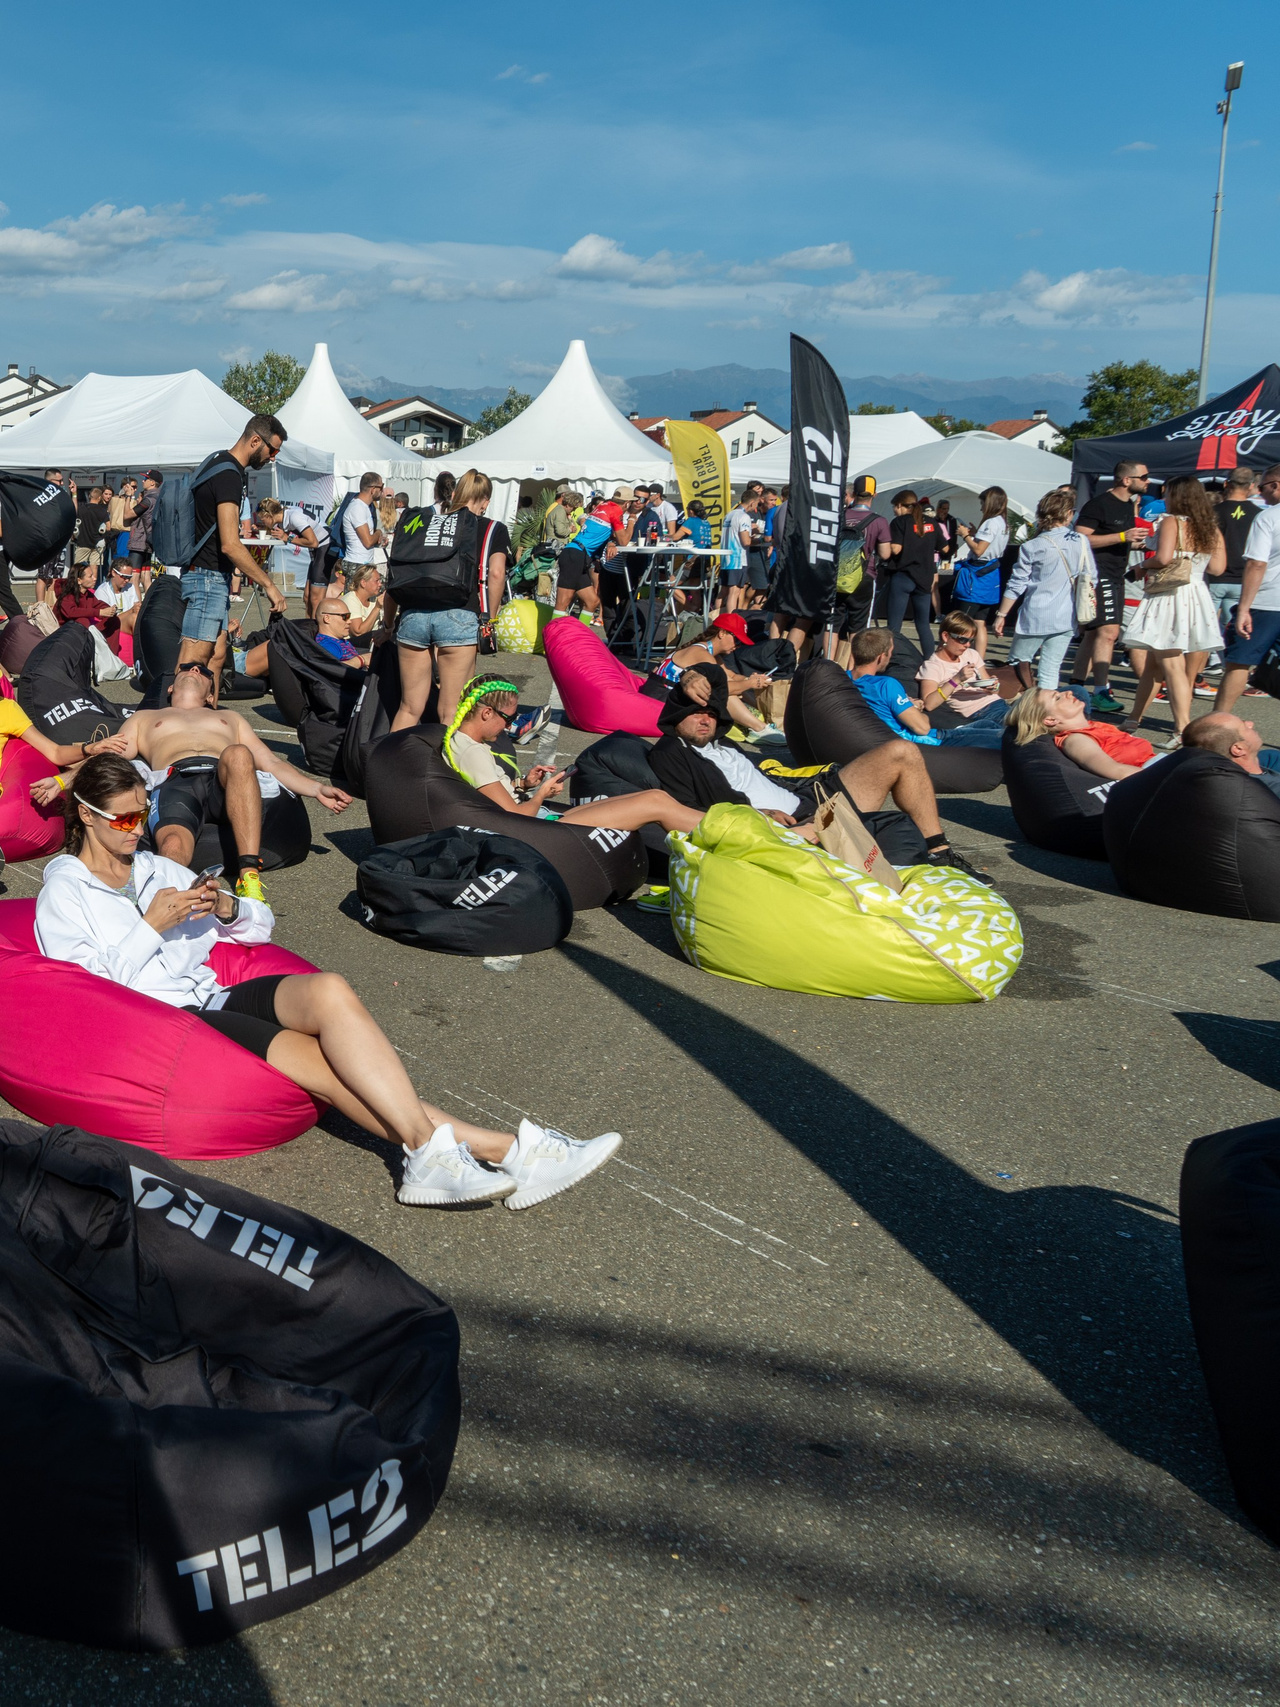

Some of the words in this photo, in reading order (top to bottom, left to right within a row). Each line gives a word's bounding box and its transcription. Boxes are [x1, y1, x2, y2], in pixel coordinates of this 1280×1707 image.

[33, 484, 61, 506] TELE2
[801, 426, 842, 564] TELE2
[588, 827, 631, 853] TEL
[452, 868, 518, 910] TELE2
[176, 1458, 408, 1612] TELE2
